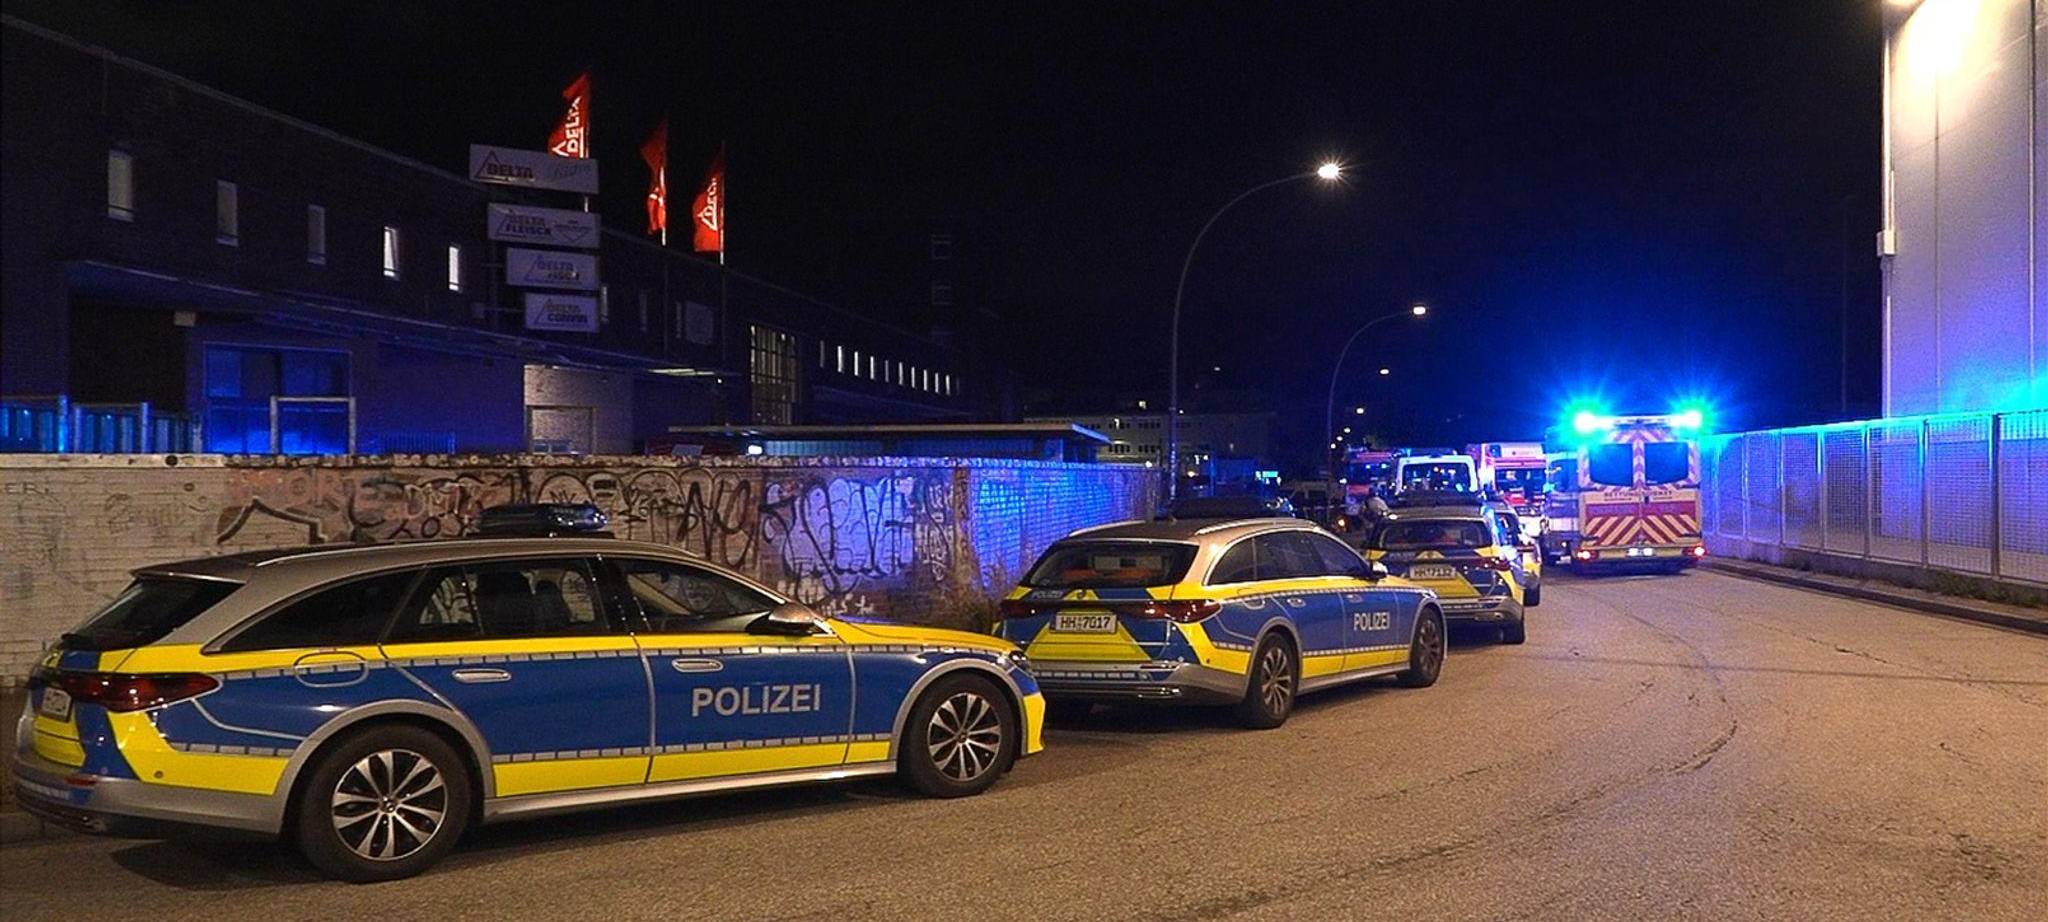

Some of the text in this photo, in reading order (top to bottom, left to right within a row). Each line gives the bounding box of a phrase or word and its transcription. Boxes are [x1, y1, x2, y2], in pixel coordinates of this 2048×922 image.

[486, 162, 534, 178] DELTA
[536, 259, 574, 272] DELTA
[1060, 616, 1111, 629] HH 7017
[1353, 611, 1390, 631] POLIZEI
[691, 684, 821, 717] POLIZEI
